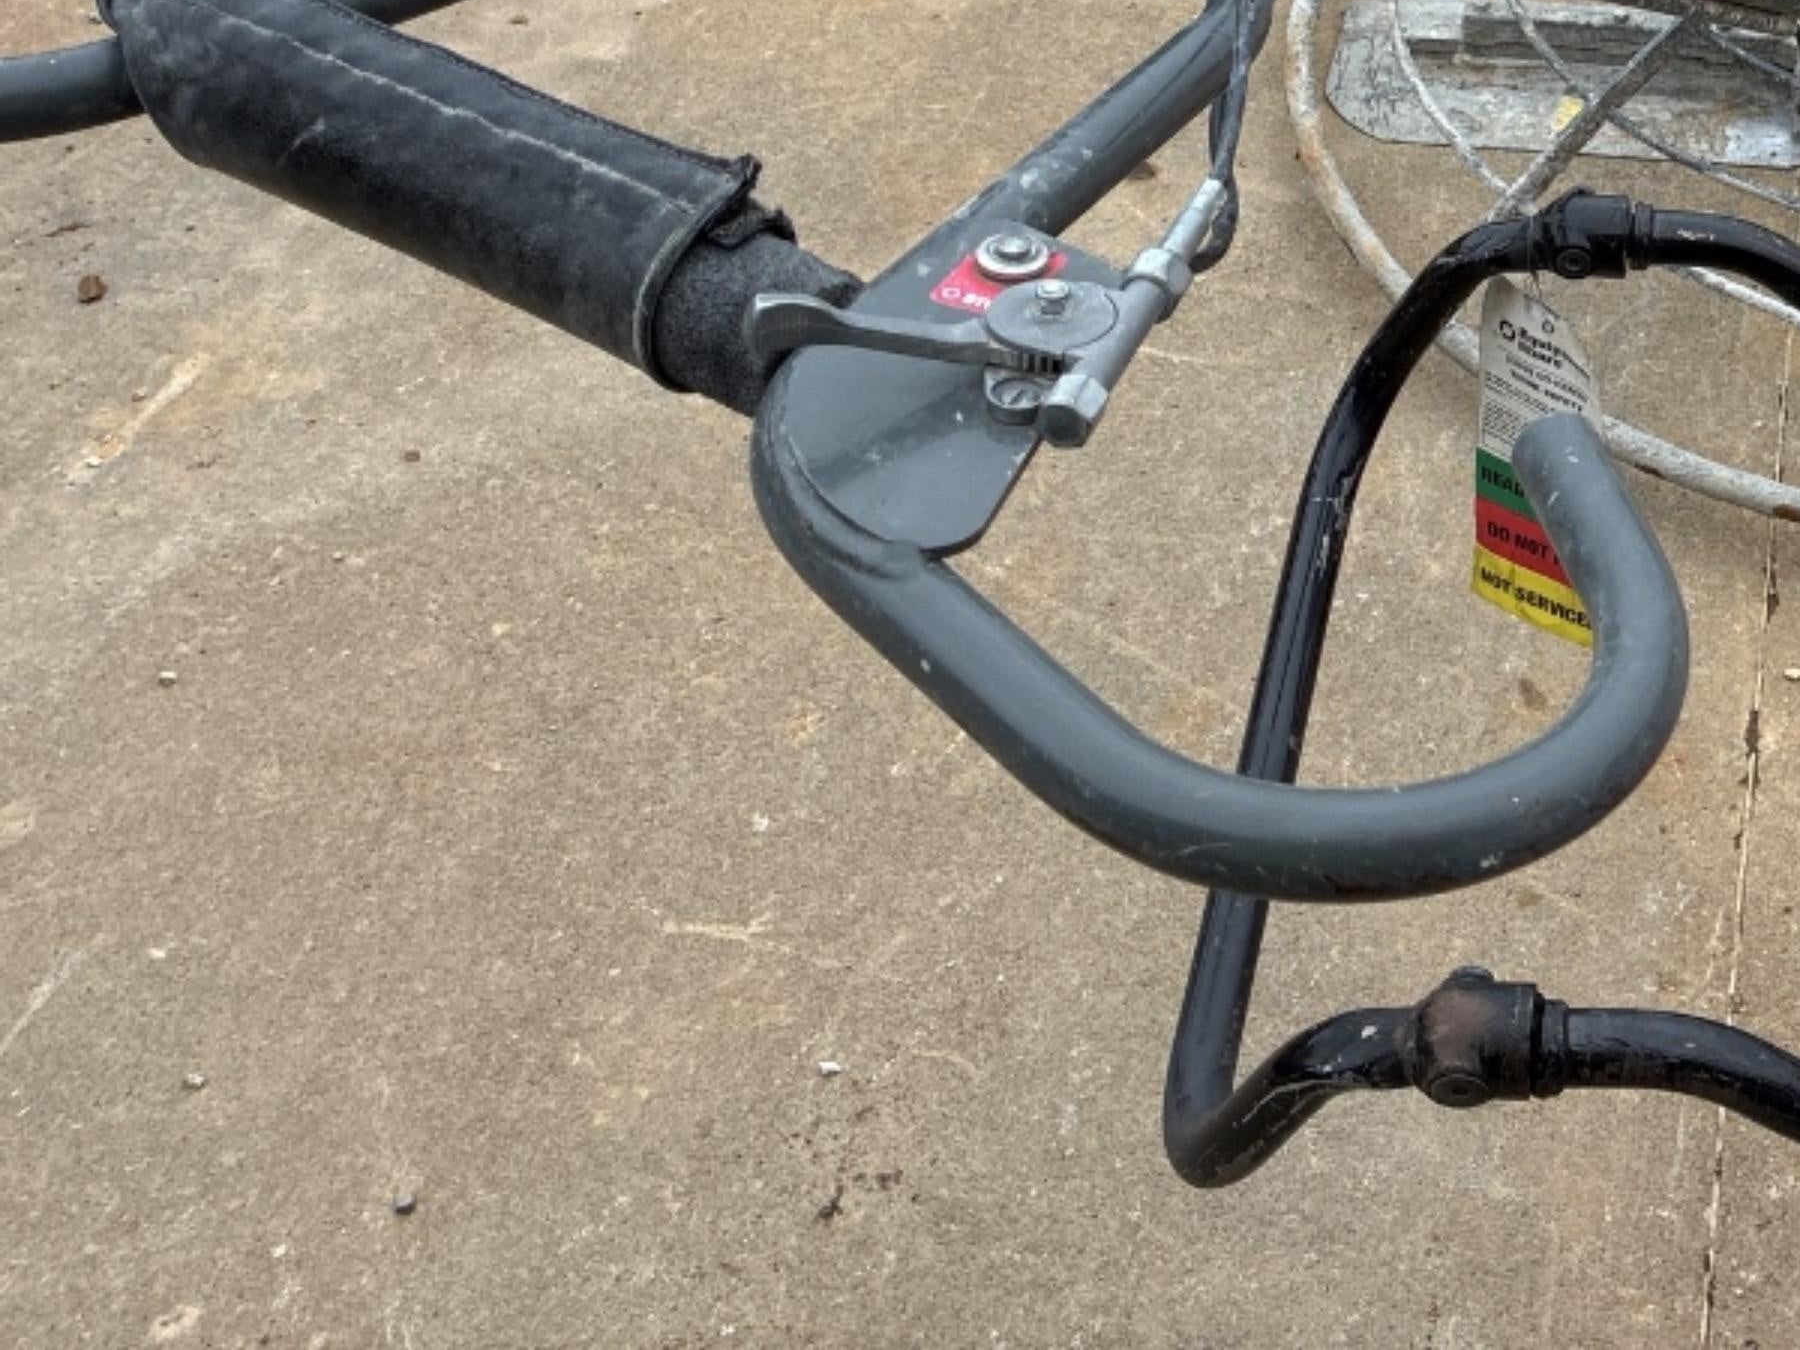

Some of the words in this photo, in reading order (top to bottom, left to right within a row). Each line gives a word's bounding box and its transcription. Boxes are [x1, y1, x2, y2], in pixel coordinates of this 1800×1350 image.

[1487, 521, 1510, 543] DO
[1513, 533, 1549, 559] NOT
[1481, 567, 1512, 593] NOT
